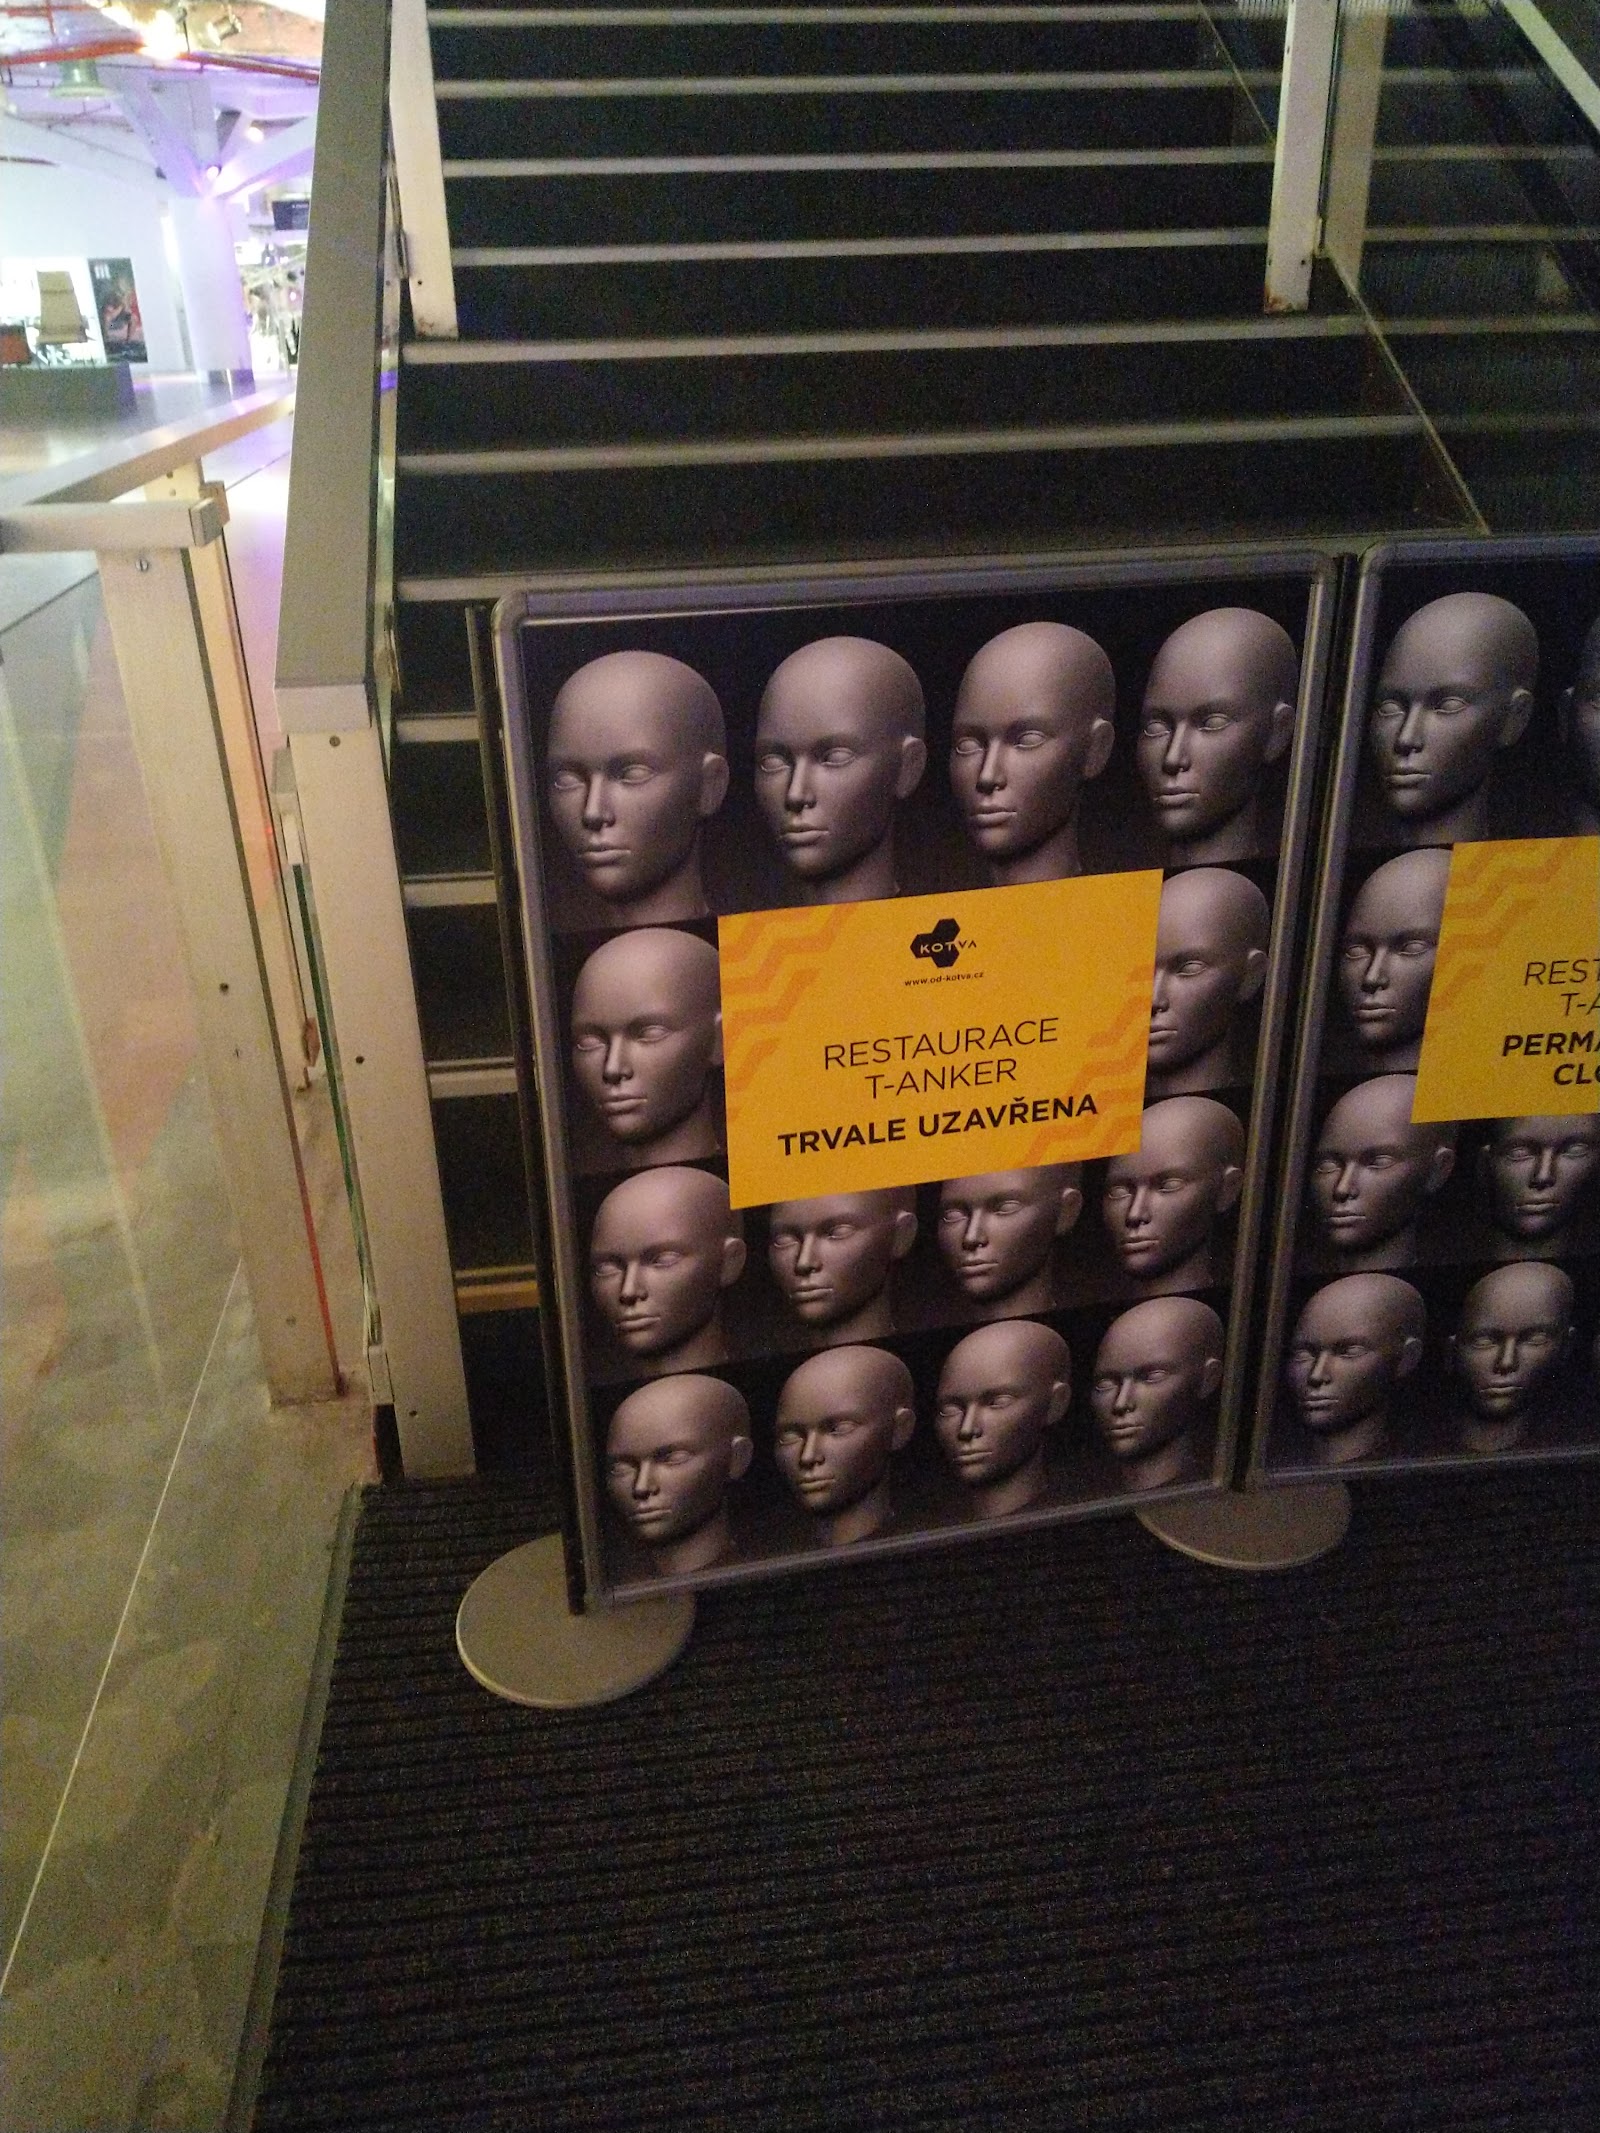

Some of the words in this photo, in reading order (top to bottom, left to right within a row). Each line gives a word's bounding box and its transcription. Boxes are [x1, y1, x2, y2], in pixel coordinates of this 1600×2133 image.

[920, 940, 976, 954] KOTVA
[905, 972, 984, 986] www.od-kotva.cz
[824, 1018, 1059, 1069] RESTAURACE
[1502, 1030, 1600, 1056] PERM
[866, 1058, 1017, 1099] T-ANKER
[1553, 1063, 1600, 1085] CL
[778, 1119, 906, 1155] TRVALE
[919, 1093, 1098, 1137] UZAVŘENA
